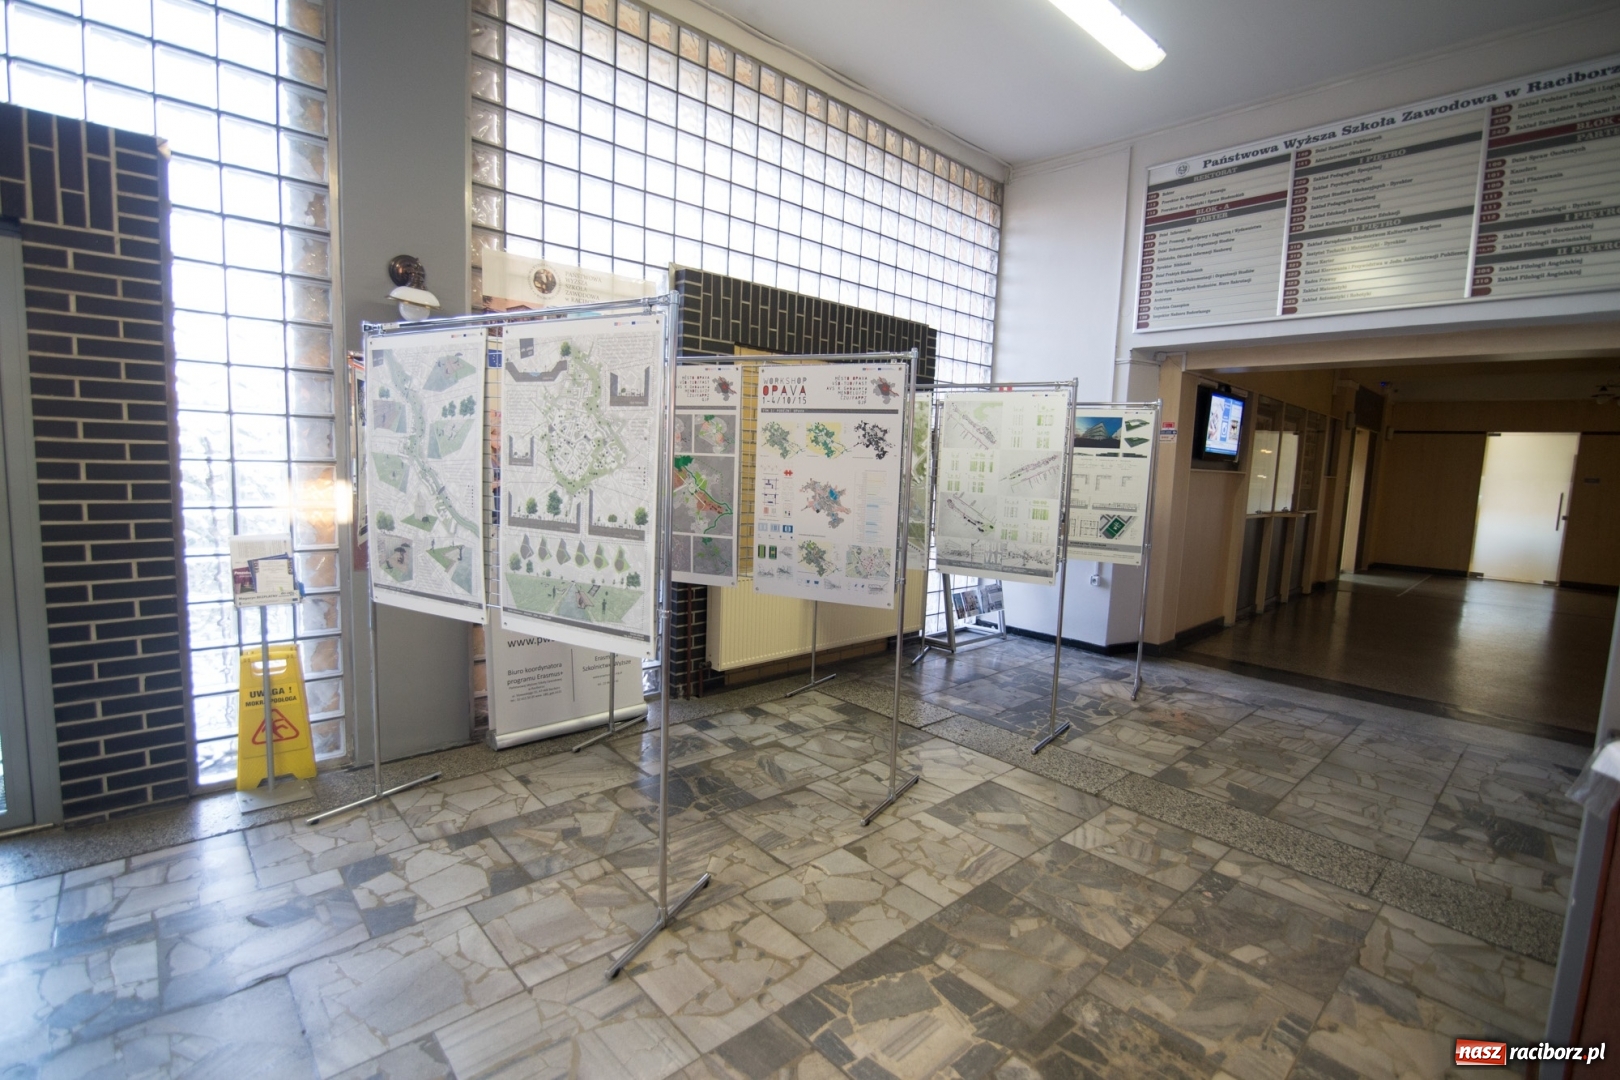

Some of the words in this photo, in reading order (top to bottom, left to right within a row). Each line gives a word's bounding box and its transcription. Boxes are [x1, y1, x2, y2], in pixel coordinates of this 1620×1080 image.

[1203, 145, 1279, 168] Państwowa
[1283, 132, 1337, 149] Wyższa
[1341, 116, 1396, 137] Szkoła
[1402, 93, 1498, 122] Zawodowa
[1504, 87, 1521, 98] w
[1575, 116, 1614, 130] BLOK
[1364, 148, 1406, 163] PIĘTRO
[1193, 166, 1237, 182] REKTORAT
[1195, 206, 1215, 215] BLOK
[1195, 212, 1227, 223] PARTER
[763, 377, 807, 385] WORKSHOP
[763, 385, 807, 396] OPAVA
[507, 636, 555, 648] www.pw
[525, 662, 563, 672] koordynatora
[507, 676, 536, 686] programu
[537, 671, 564, 680] Erasmus+
[249, 688, 285, 698] UWGA
